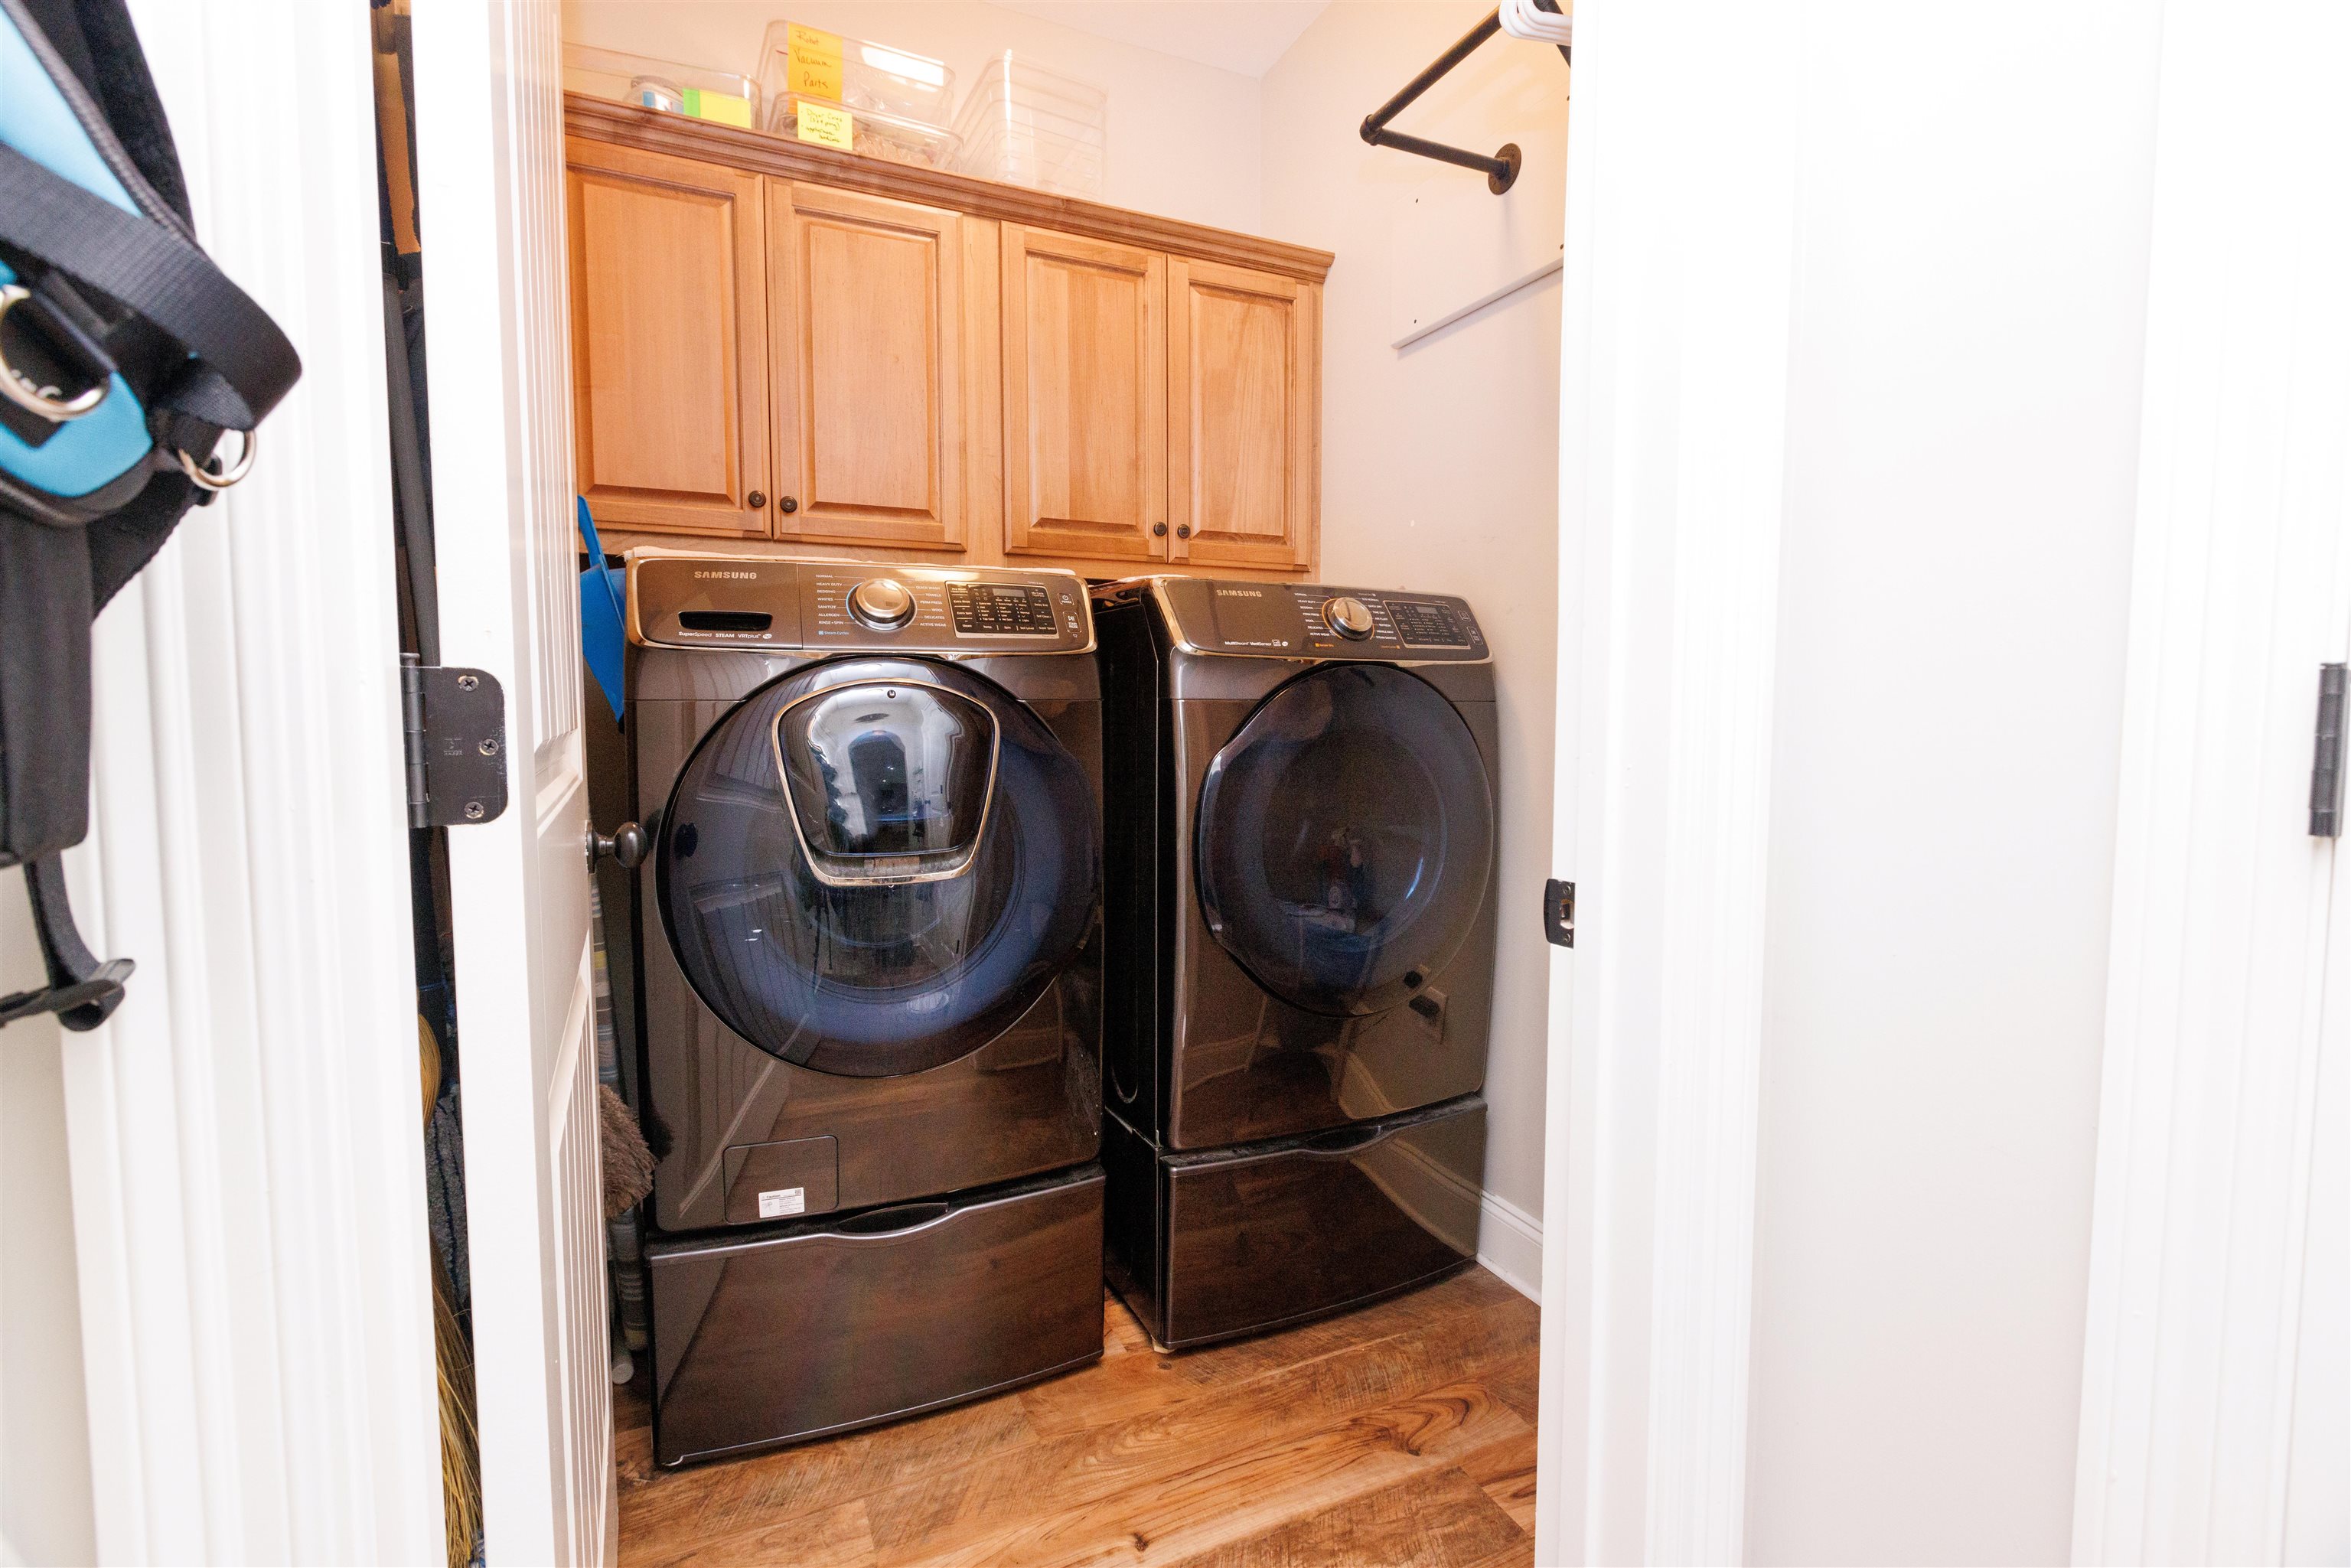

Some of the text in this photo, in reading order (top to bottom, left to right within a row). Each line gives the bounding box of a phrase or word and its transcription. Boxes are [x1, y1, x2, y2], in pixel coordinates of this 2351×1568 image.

[794, 47, 832, 67] Vacuum
[804, 70, 828, 89] Parts
[693, 571, 757, 580] SAMSUNG
[1216, 589, 1262, 598] SAMSUNG
